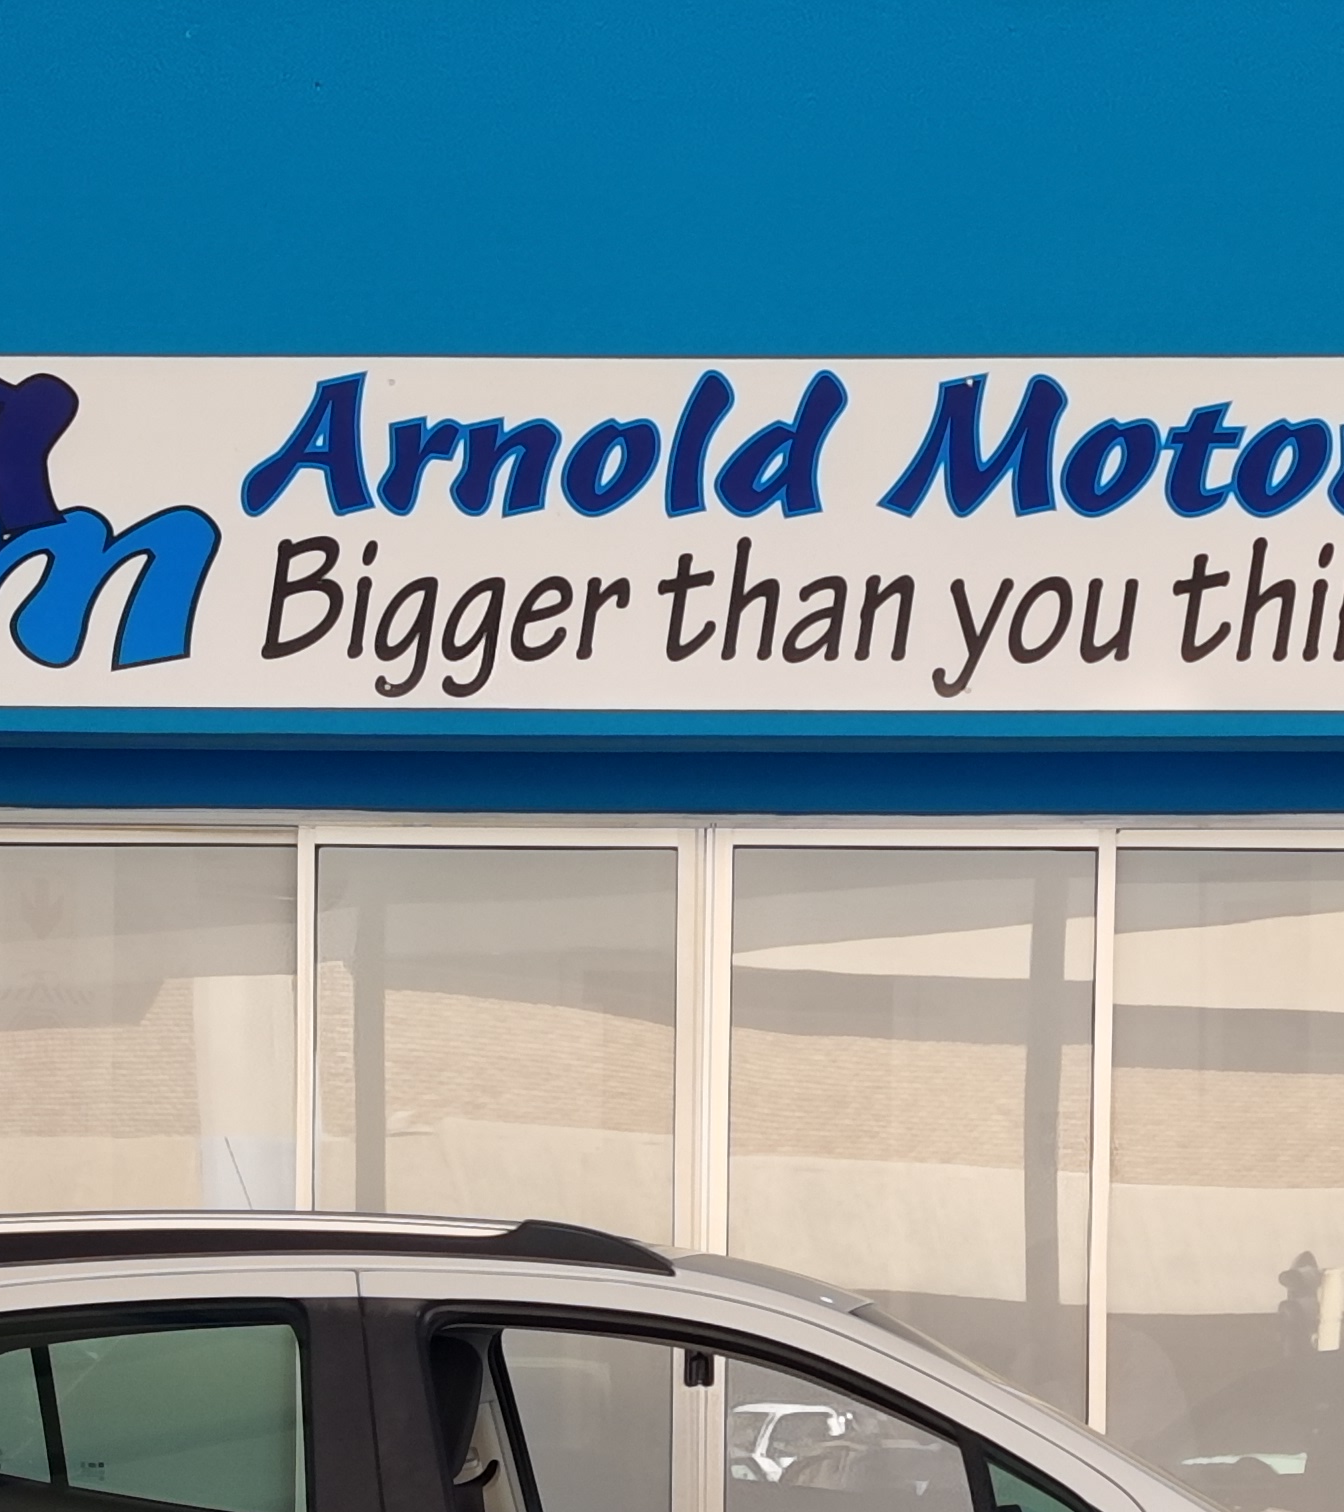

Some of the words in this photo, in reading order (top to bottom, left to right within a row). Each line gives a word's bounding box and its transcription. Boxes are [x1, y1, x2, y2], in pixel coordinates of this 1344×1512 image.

[240, 370, 848, 518] Arnold
[261, 535, 631, 698] Bigger
[657, 537, 916, 664] than
[931, 575, 1140, 699] you
